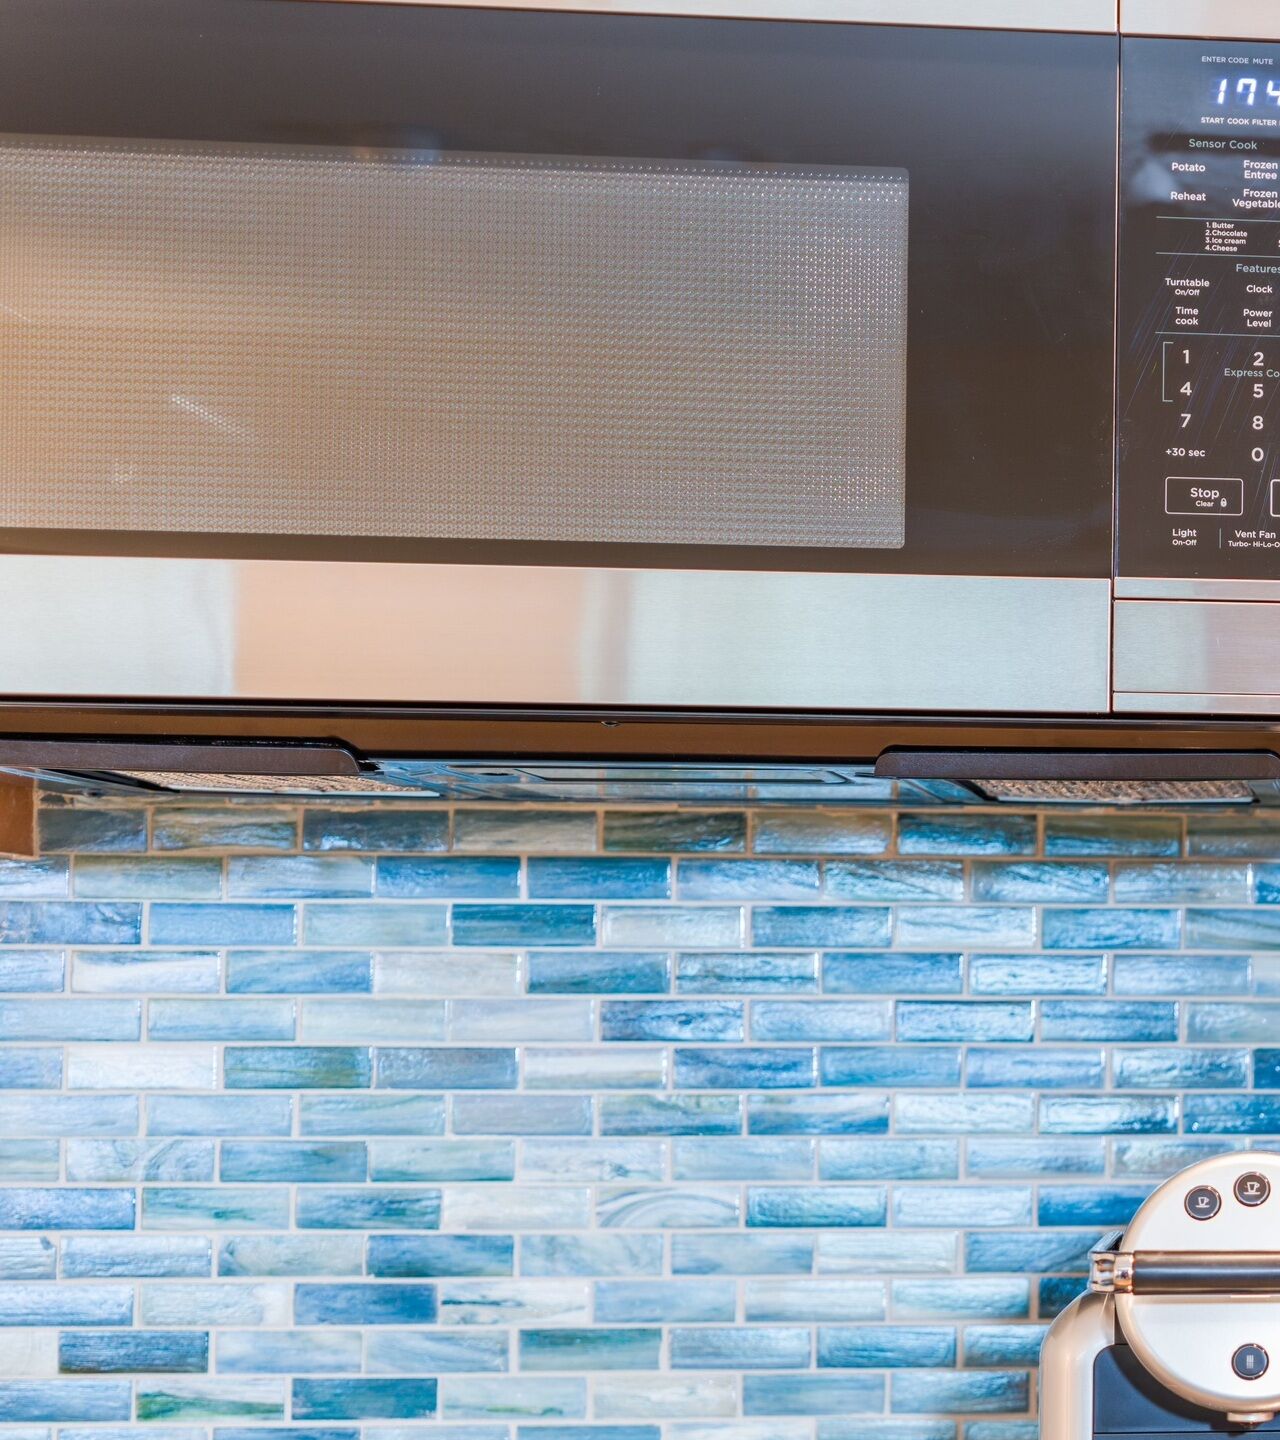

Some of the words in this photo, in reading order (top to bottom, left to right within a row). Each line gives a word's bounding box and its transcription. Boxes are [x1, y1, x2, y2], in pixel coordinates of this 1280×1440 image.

[1189, 139, 1226, 148] Sensor
[1230, 140, 1257, 149] Cook
[1172, 162, 1205, 171] Potato
[1244, 160, 1278, 169] Frozen
[1245, 170, 1277, 179] Entree
[1169, 190, 1206, 200] Reheat
[1244, 189, 1277, 198] Frozen
[1165, 278, 1209, 287] Turntable
[1247, 285, 1272, 293] Clock
[1176, 307, 1198, 315] Time
[1244, 309, 1272, 317] Power
[1176, 317, 1198, 325] cook
[1247, 319, 1271, 327] Level
[1183, 350, 1189, 363] 1
[1253, 352, 1263, 366] 2
[1224, 368, 1263, 377] Express
[1180, 382, 1192, 395] 4
[1253, 384, 1263, 398] 5
[1181, 414, 1191, 427] 7
[1253, 416, 1263, 430] 8
[1166, 448, 1185, 456] +30
[1191, 488, 1219, 499] Stop
[1173, 529, 1196, 540] Light
[1235, 530, 1256, 538] Vent
